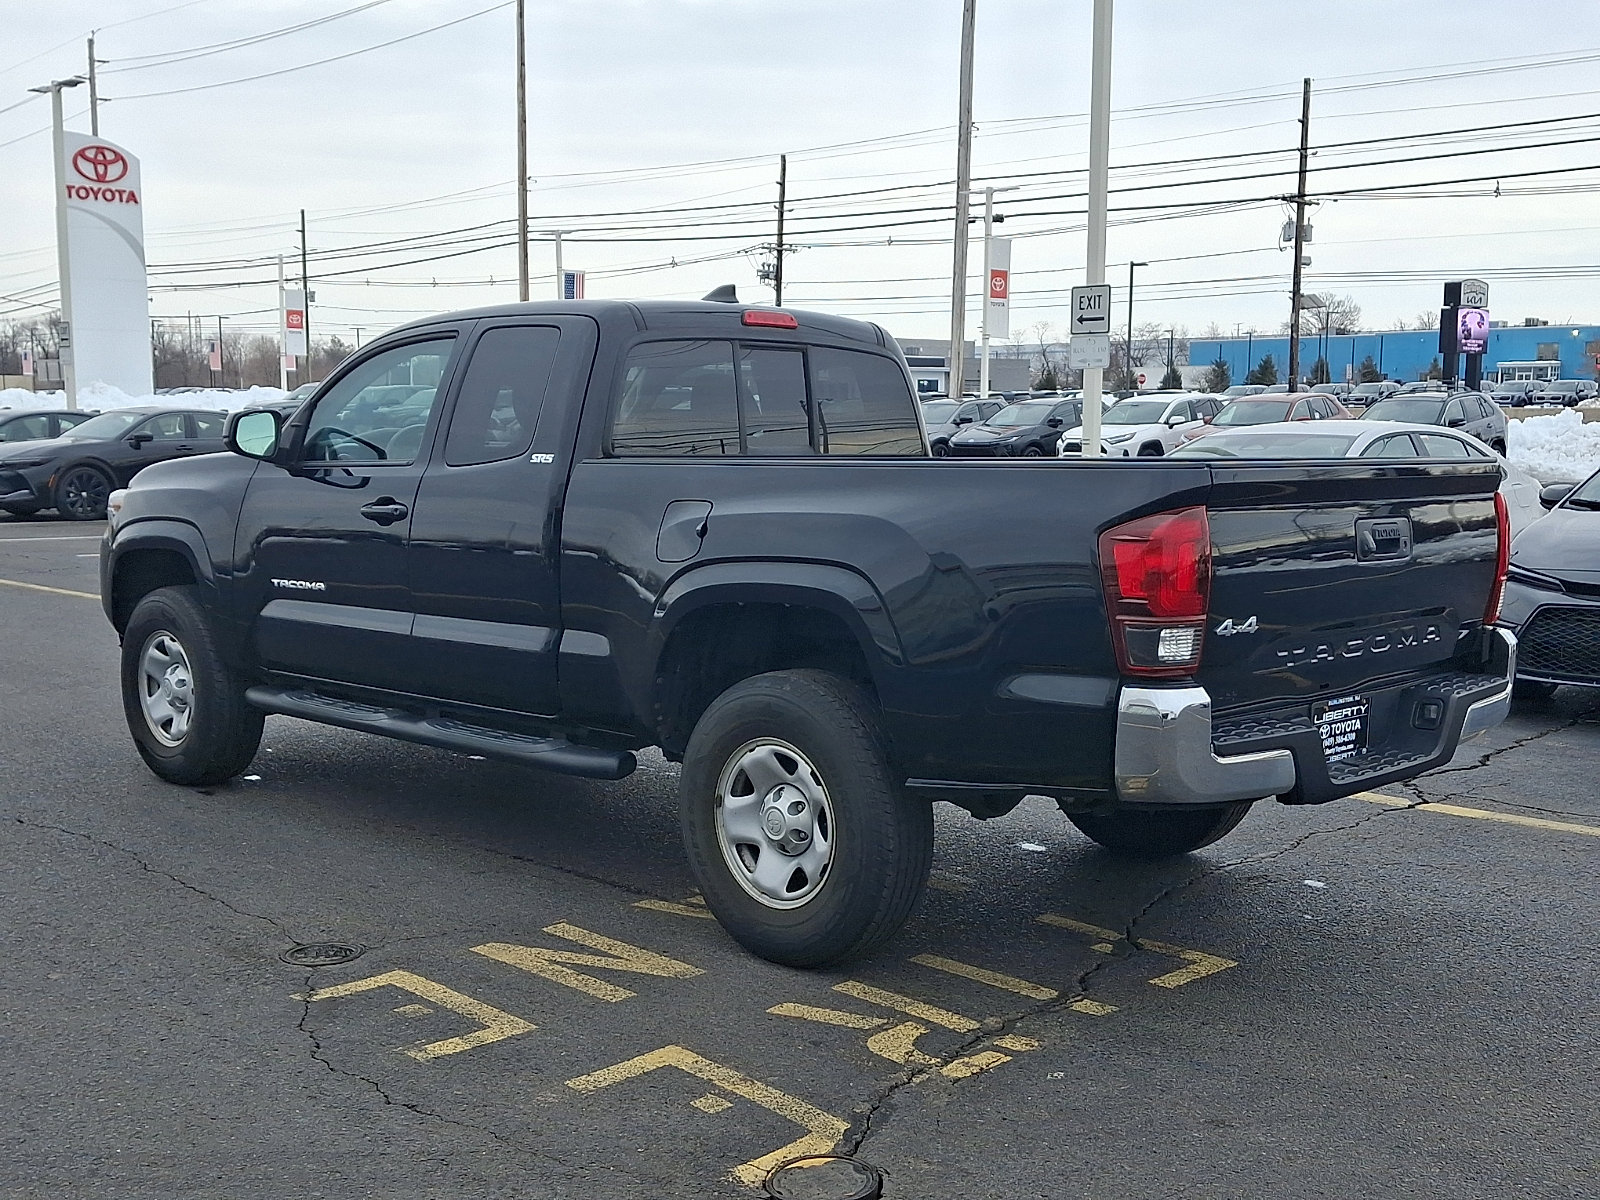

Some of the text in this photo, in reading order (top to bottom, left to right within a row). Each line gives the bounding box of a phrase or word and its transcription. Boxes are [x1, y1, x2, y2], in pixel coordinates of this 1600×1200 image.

[66, 184, 139, 205] TOYOTA
[1079, 294, 1102, 310] EXIT
[1376, 528, 1401, 538] TOYOTA
[270, 578, 326, 592] TACOMA
[1276, 623, 1442, 667] TACOMA
[1314, 704, 1368, 723] LIBERTY
[1331, 718, 1361, 735] TOYOTA
[566, 913, 1238, 1188] FIRE
